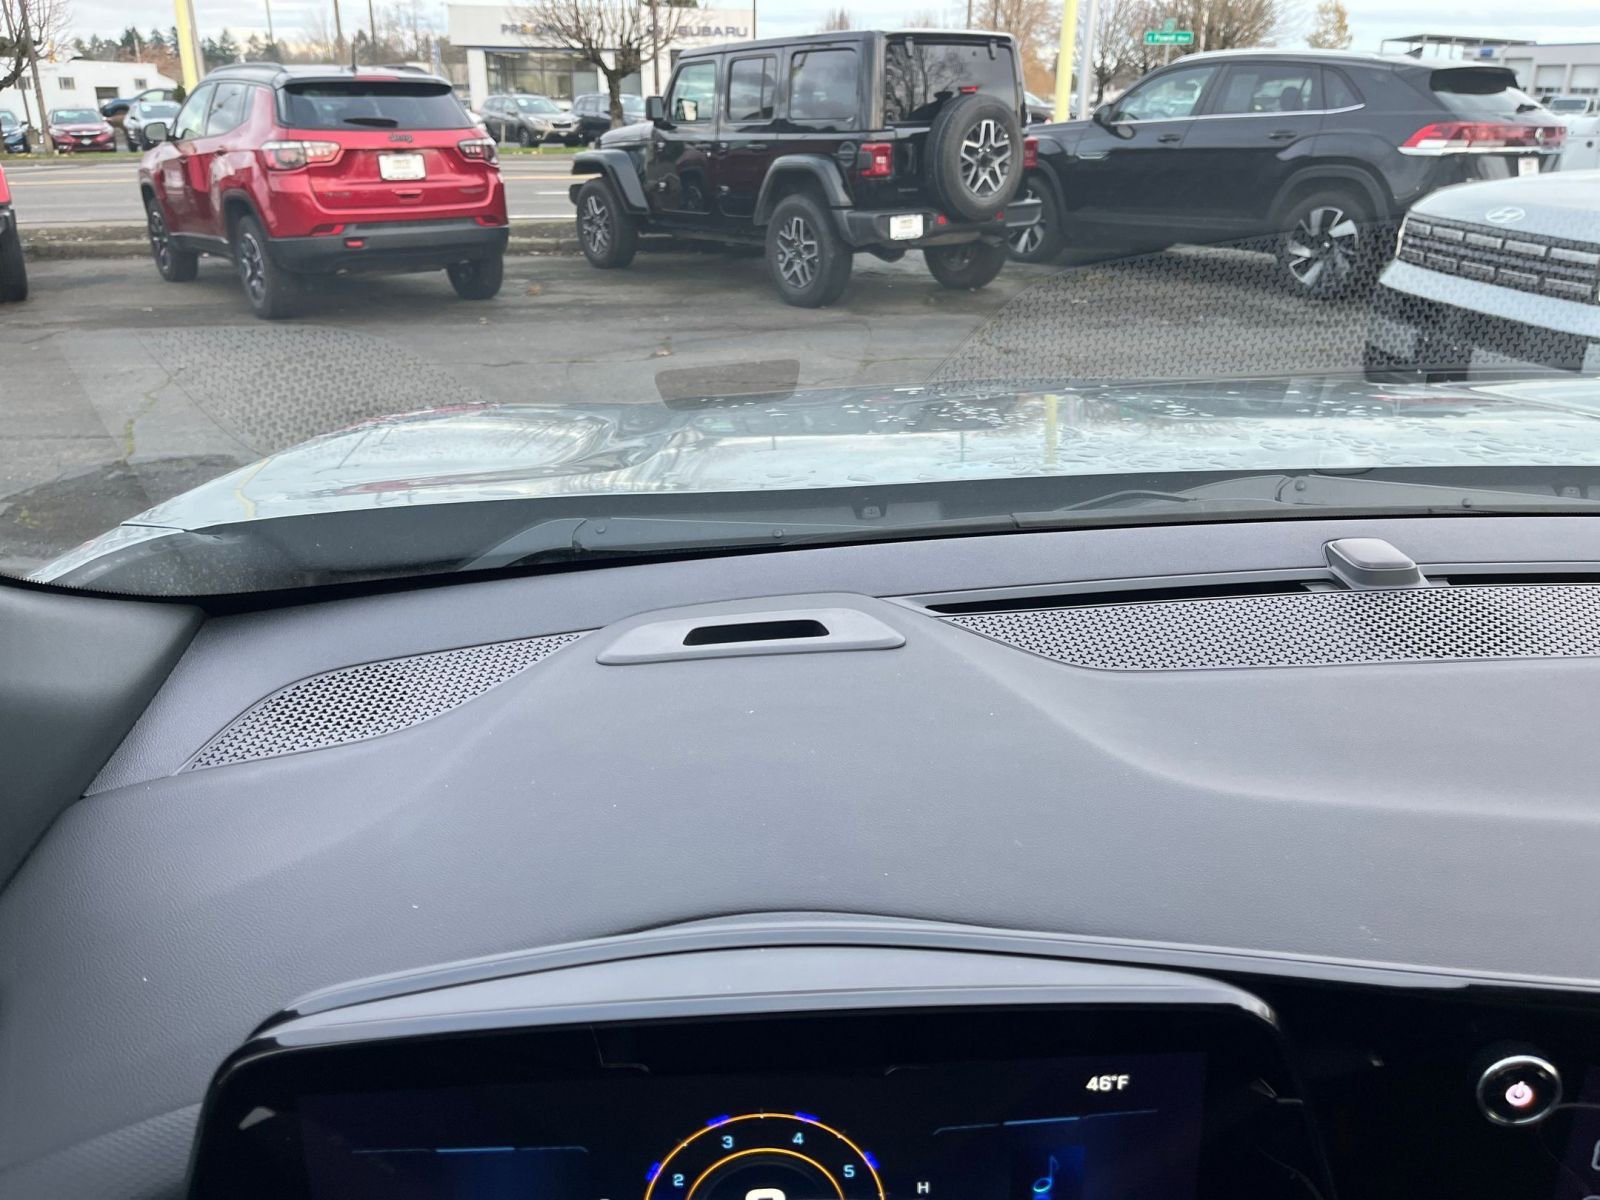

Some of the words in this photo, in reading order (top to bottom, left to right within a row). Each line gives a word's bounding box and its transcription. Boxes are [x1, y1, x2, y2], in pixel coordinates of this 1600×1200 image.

[677, 25, 748, 37] SUBARU
[1085, 1074, 1130, 1091] 46°F
[721, 1135, 734, 1149] 3
[792, 1132, 804, 1145] 4
[843, 1164, 855, 1178] 5
[672, 1173, 684, 1187] 2
[916, 1181, 930, 1195] H
